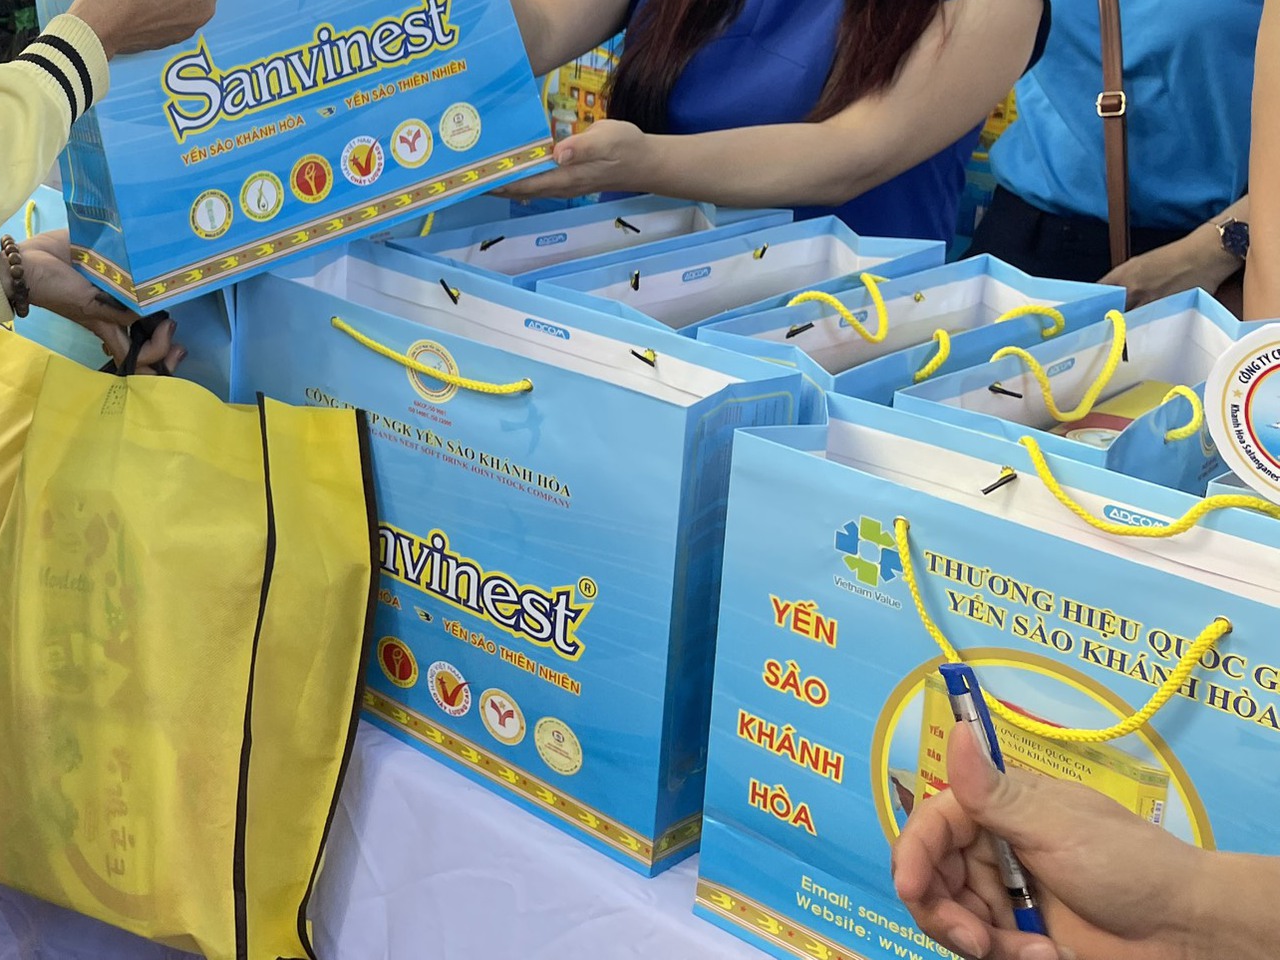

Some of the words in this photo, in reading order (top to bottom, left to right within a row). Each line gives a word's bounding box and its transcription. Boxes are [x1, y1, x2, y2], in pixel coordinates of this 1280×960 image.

[182, 147, 207, 166] YẾN
[209, 137, 234, 156] SÀO
[236, 123, 276, 147] KHÁNH
[279, 114, 305, 132] HÒA
[344, 90, 370, 110] YẾN
[372, 84, 395, 102] SÀO
[397, 71, 430, 92] THIÊN
[431, 59, 467, 84] NHIÊN
[528, 320, 567, 340] ADCOM
[1238, 360, 1261, 384] CÔNG
[1257, 352, 1271, 366] TY
[305, 387, 339, 409] CÔNG
[382, 416, 412, 438] NGK
[415, 428, 443, 448] YẾN
[447, 440, 475, 461] SÀO
[479, 452, 533, 483] KHÁNH
[537, 473, 571, 498] HÒA
[1230, 403, 1241, 431] Khanh
[1235, 429, 1246, 445] Hoa
[421, 446, 441, 459] SOFT
[442, 454, 469, 470] DRINK
[496, 475, 525, 492] STOCK
[526, 486, 571, 509] COMPANY
[1242, 443, 1280, 482] Salanganes
[379, 526, 585, 656] nvinest
[833, 575, 872, 598] Vietnam
[873, 591, 902, 609] Value
[924, 550, 1055, 613] THƯƠNG
[1060, 597, 1143, 642] HIỆU
[770, 594, 837, 648] YẾN
[442, 618, 469, 643] YẾN
[470, 631, 496, 655] SÀO
[499, 647, 537, 675] THIÊN
[538, 663, 581, 696] NHIÊN
[946, 590, 1006, 629] YẾN
[1013, 614, 1073, 652] SÀO
[1080, 638, 1200, 701] KHÁNH
[1205, 681, 1280, 731] HÒA
[763, 659, 828, 707] SÀO
[738, 709, 844, 784] KHÁNH
[1074, 761, 1092, 775] GIA
[749, 777, 817, 836] HÒA
[796, 892, 872, 940] Website:
[801, 875, 853, 912] Email:
